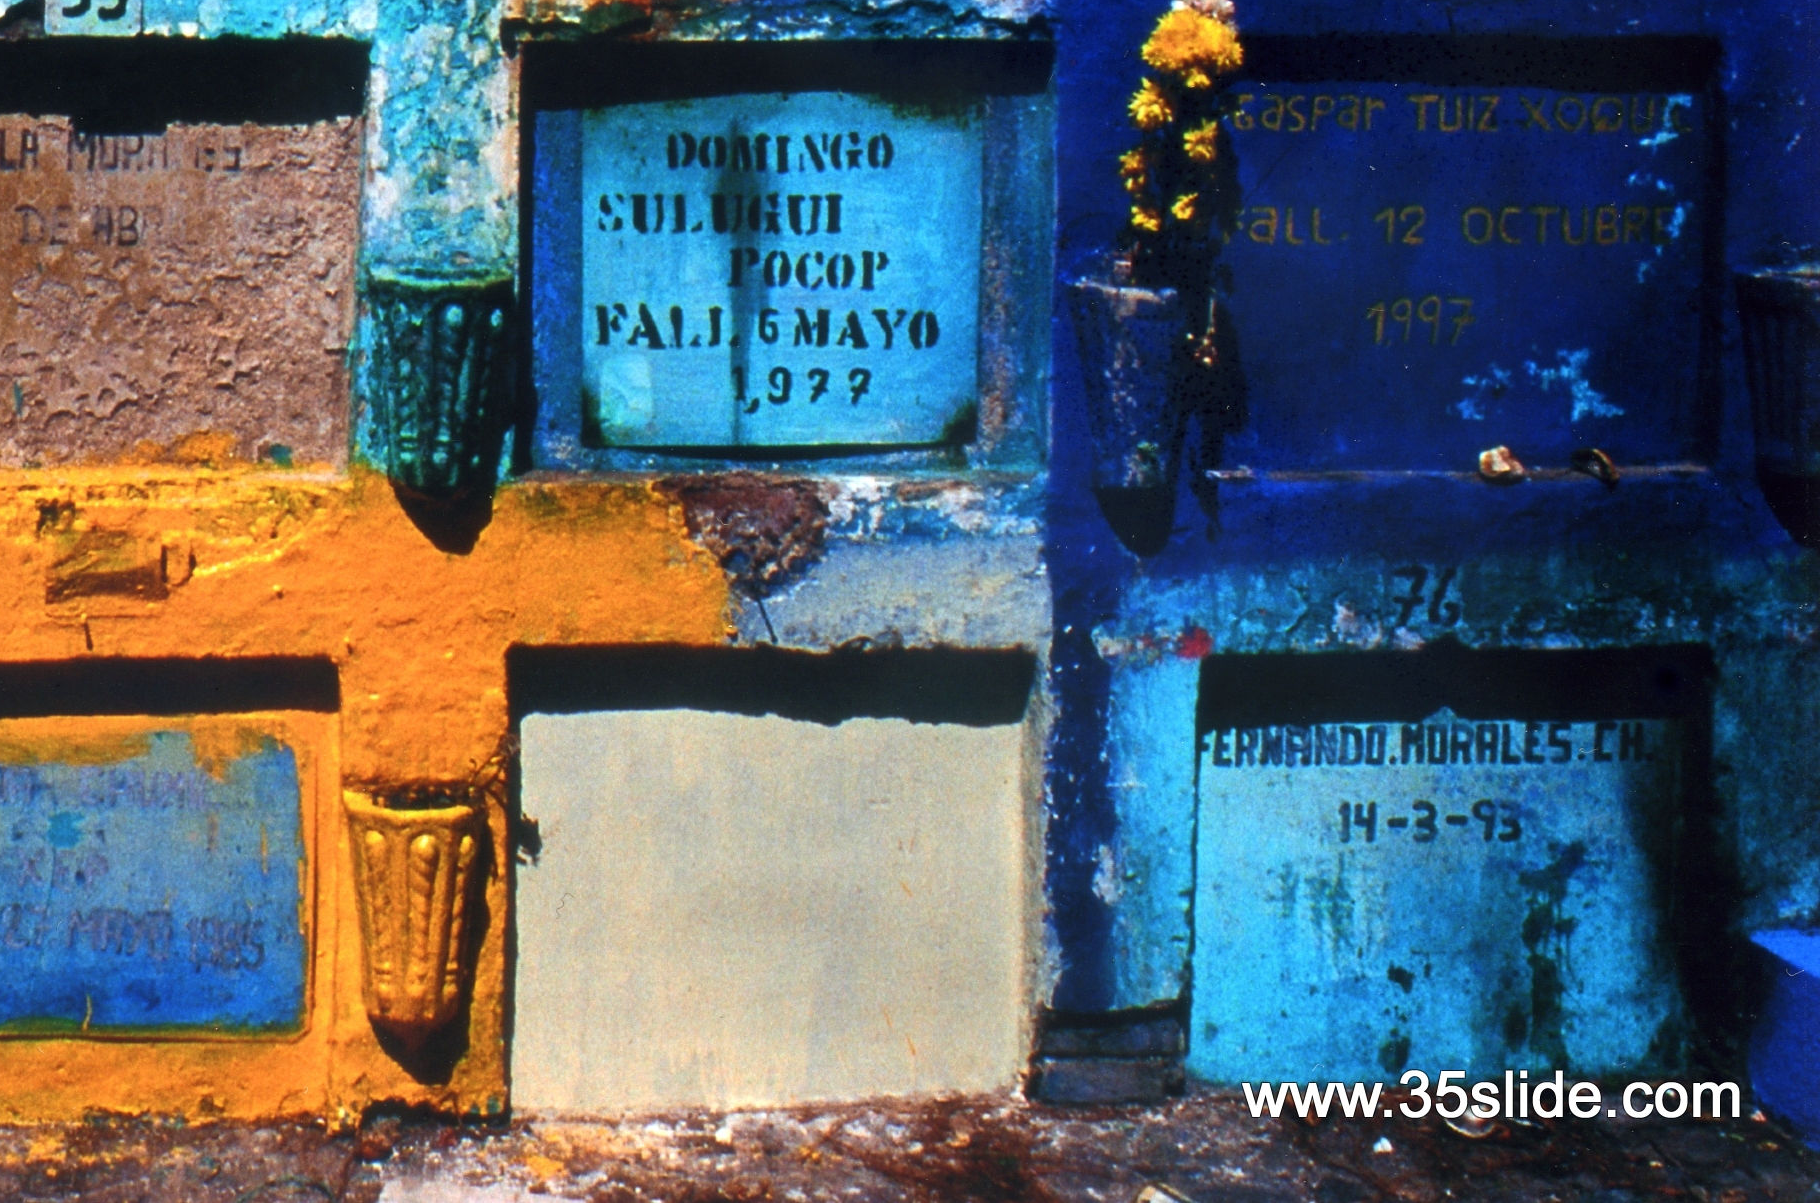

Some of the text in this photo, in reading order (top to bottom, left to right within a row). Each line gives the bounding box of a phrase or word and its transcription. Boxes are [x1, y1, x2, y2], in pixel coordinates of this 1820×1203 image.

[666, 132, 896, 174] DOMINGO
[1373, 206, 1426, 244] 12
[726, 248, 891, 291] POCOP
[758, 307, 780, 345] 6
[792, 307, 941, 351] MAYO
